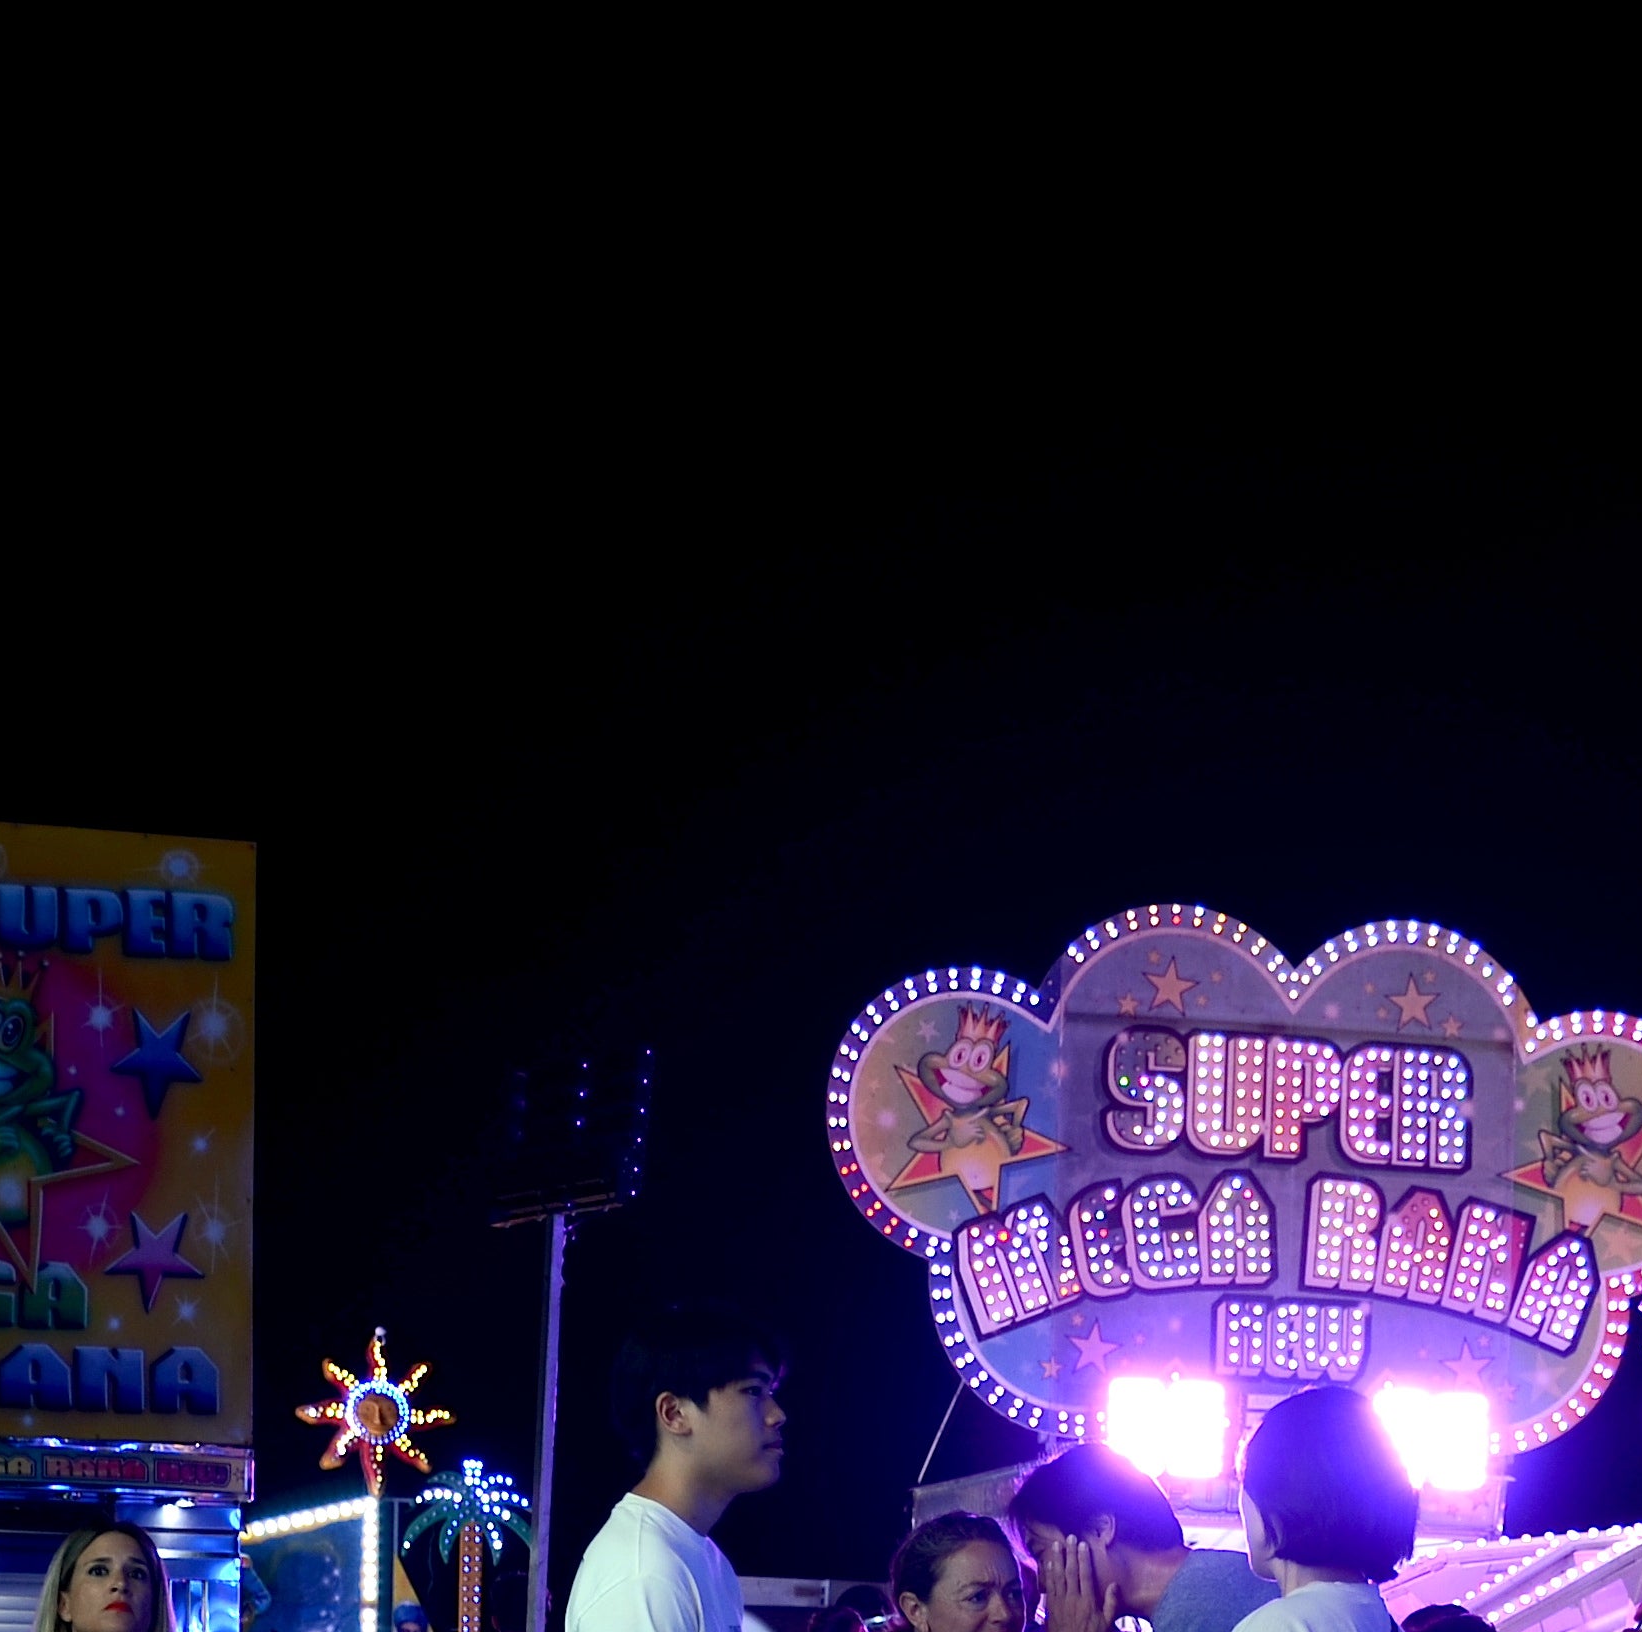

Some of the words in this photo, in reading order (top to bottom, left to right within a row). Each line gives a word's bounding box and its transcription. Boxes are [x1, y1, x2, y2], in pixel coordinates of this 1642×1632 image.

[1103, 1027, 1471, 1173] SUPER
[958, 1171, 1275, 1338] MEGA
[1304, 1172, 1601, 1356] RANA
[1215, 1300, 1367, 1381] NEW
[45, 1456, 149, 1481] RANA
